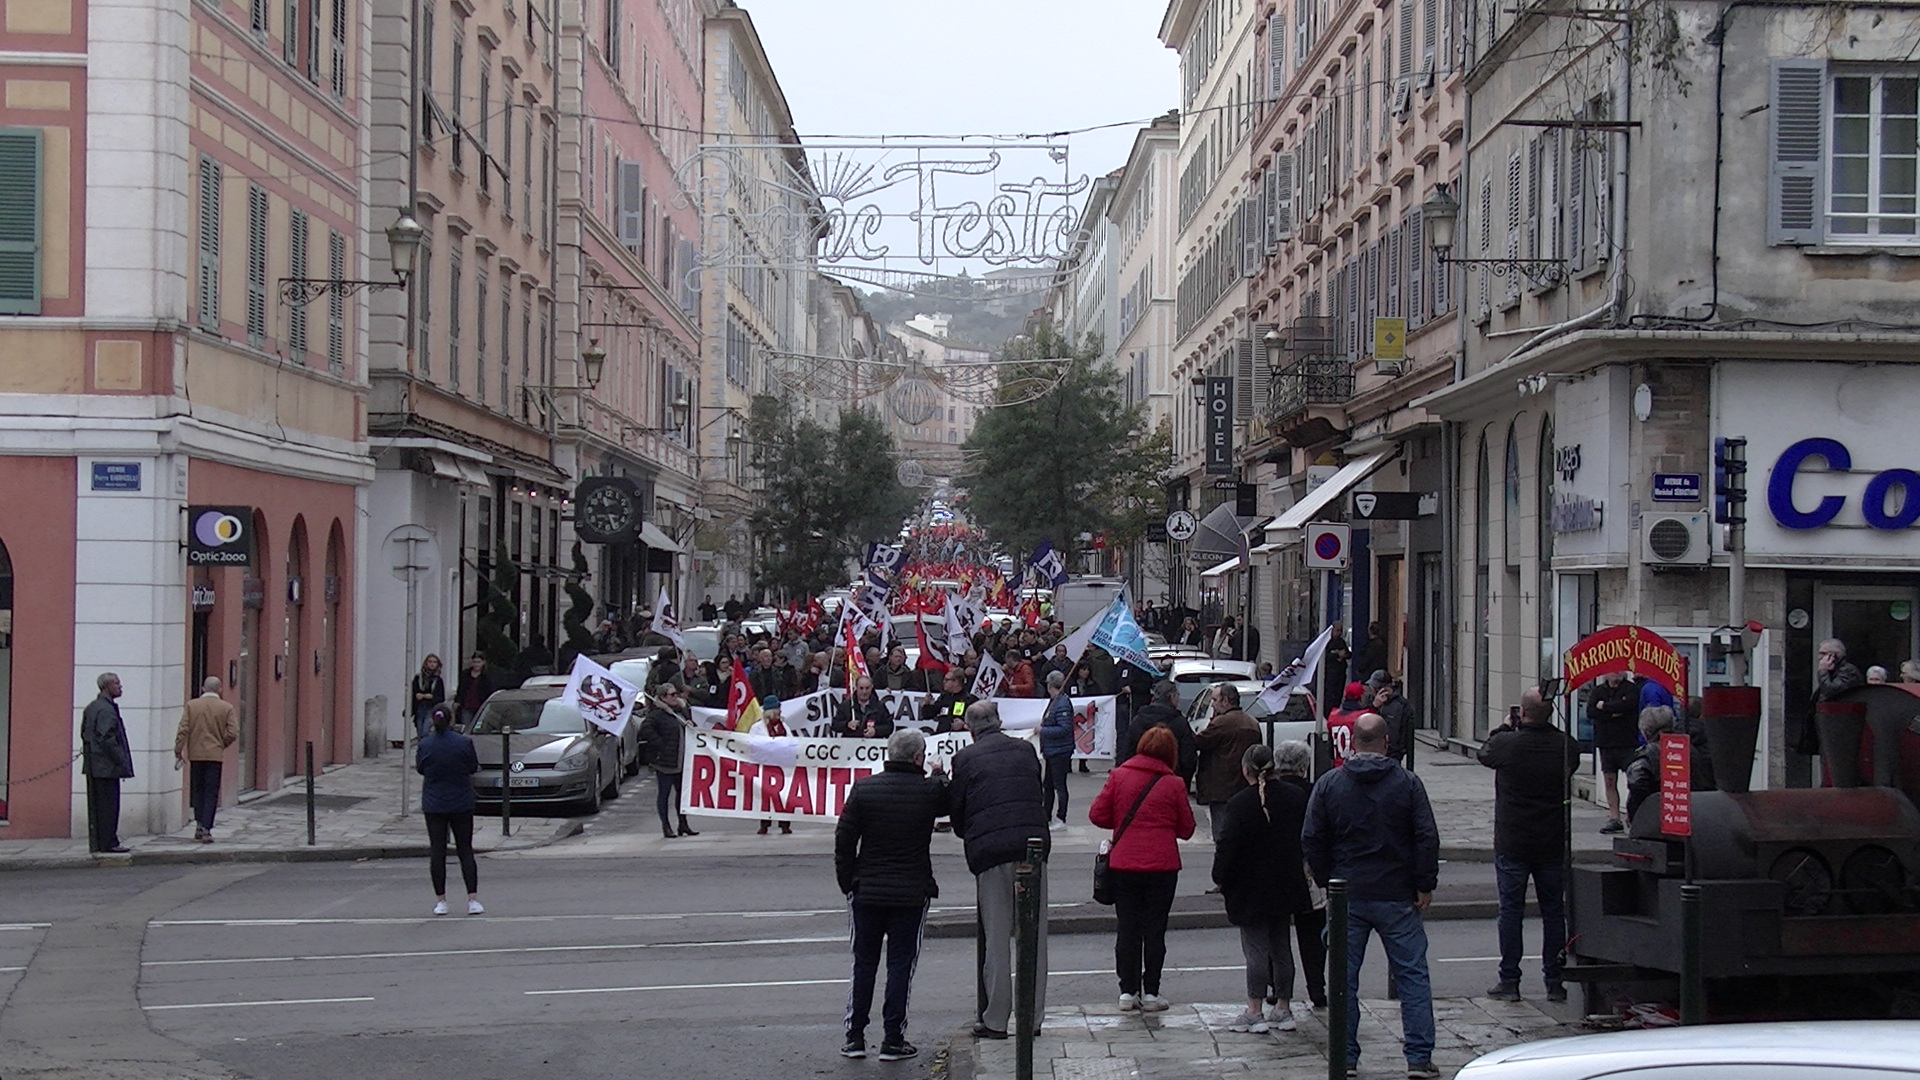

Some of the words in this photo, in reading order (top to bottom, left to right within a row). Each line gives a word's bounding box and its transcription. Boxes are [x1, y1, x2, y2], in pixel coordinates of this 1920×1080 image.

[884, 152, 1094, 265] Feste
[1212, 382, 1227, 462] HOTEL
[1767, 437, 1920, 531] Co
[1568, 638, 1631, 679] MARRONS
[1634, 640, 1681, 682] CHAUDS
[805, 744, 841, 760] CGC
[855, 745, 888, 762] CGT
